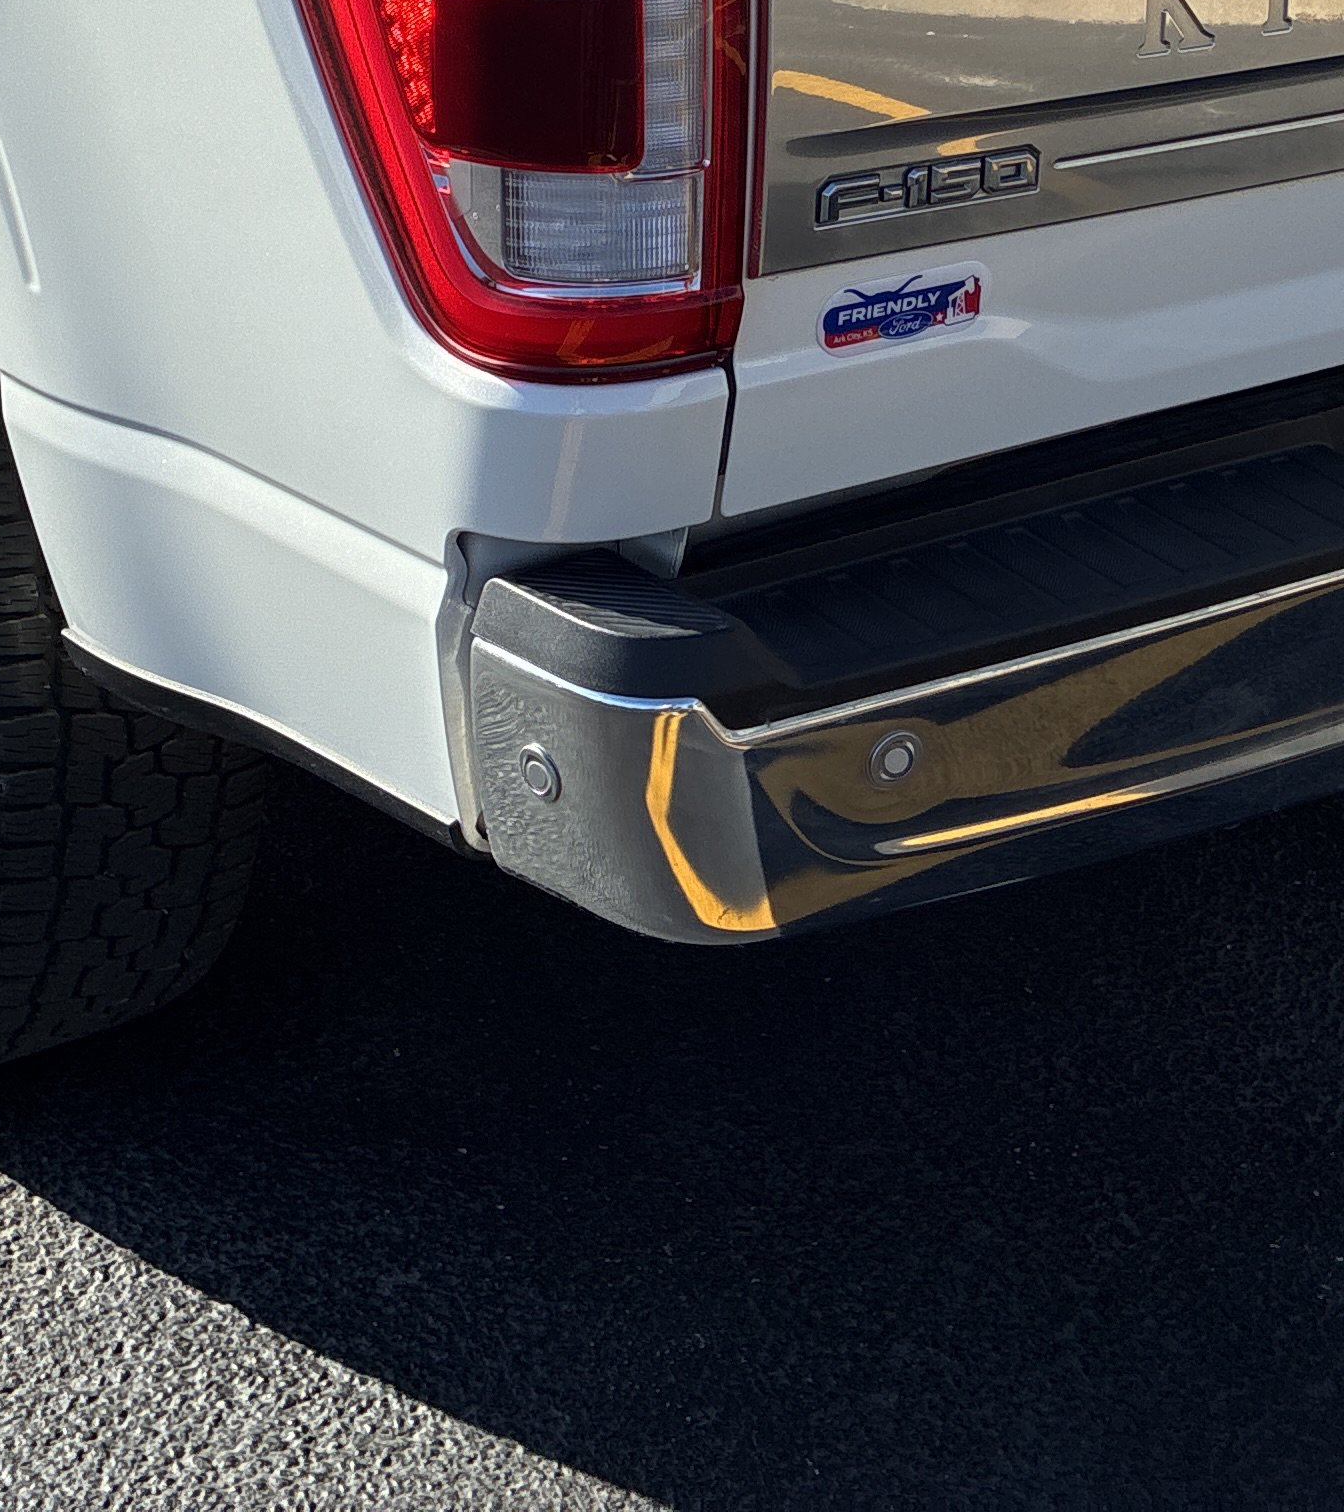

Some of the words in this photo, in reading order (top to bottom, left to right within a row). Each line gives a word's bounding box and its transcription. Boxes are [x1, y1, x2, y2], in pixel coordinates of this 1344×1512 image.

[814, 143, 1041, 229] F-150
[837, 290, 941, 326] FRIENDLY
[888, 314, 923, 335] Ford
